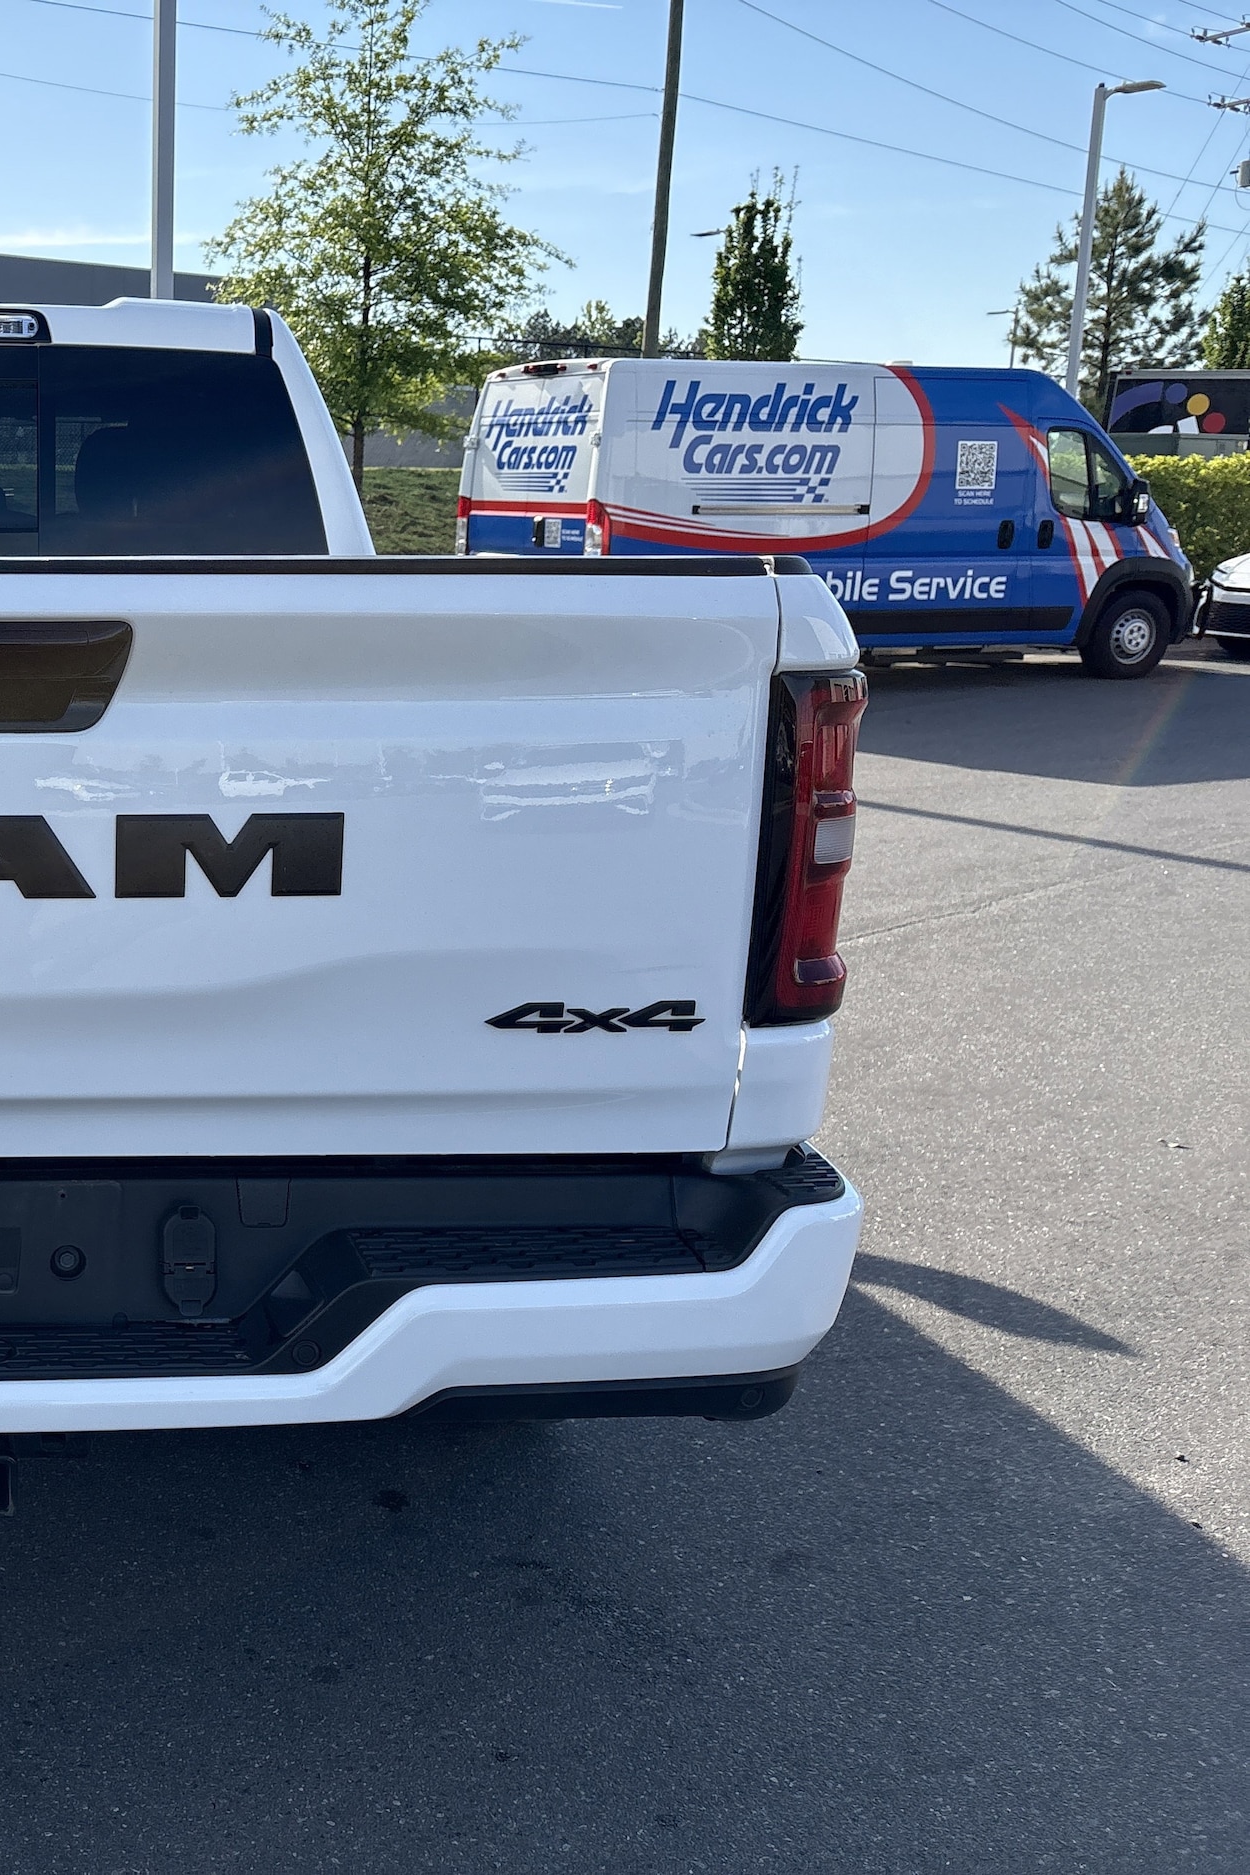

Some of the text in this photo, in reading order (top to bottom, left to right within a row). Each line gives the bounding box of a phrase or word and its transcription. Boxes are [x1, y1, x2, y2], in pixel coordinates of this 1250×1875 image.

[485, 394, 593, 452] Hendrick
[651, 380, 860, 449] Hendrick
[496, 440, 578, 471] Cars.com
[683, 434, 841, 474] Cars.com
[826, 569, 1007, 602] bile Service
[484, 1000, 706, 1033] 4x4
